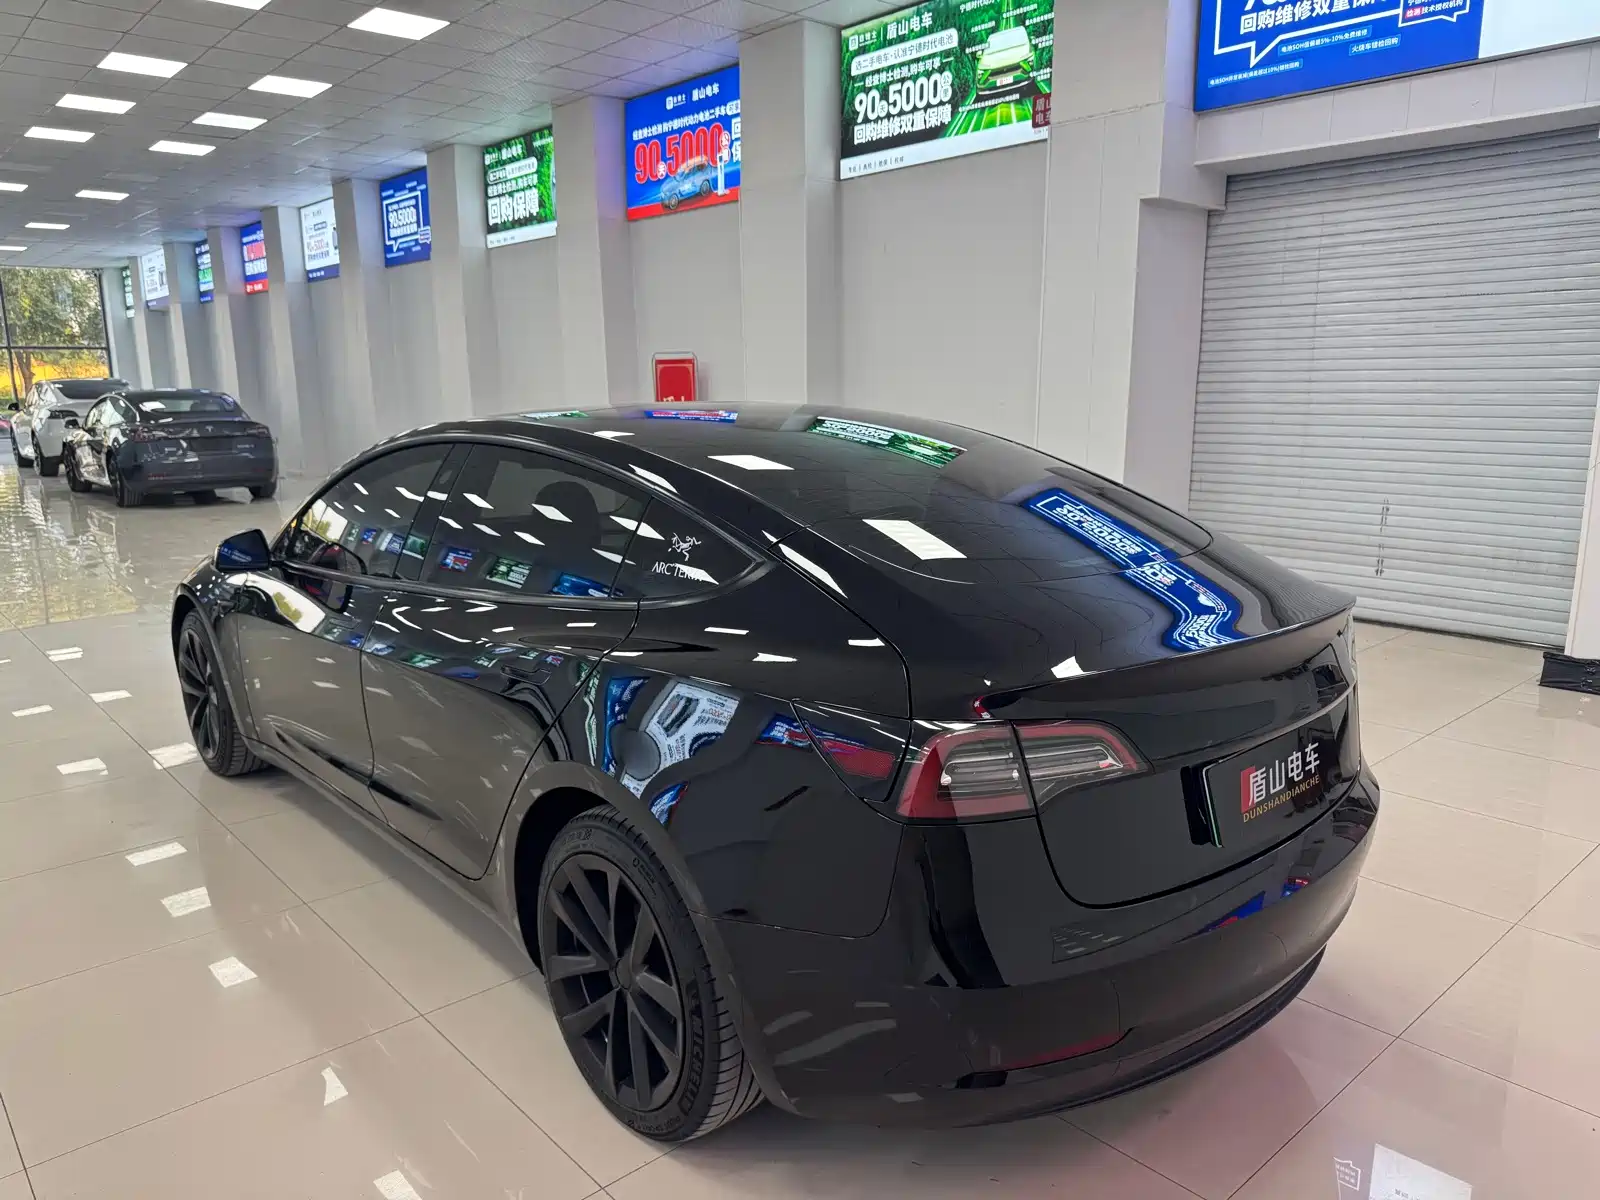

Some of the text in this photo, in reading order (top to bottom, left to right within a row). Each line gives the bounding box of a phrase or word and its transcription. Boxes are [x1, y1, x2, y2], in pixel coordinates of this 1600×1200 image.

[886, 11, 933, 40] 盾山电车
[854, 103, 952, 145] 回购维修双重保障
[487, 187, 539, 226] 回购保障
[1249, 742, 1320, 807] 盾山电车
[1243, 774, 1320, 823] DUNSHANDIANCHE
